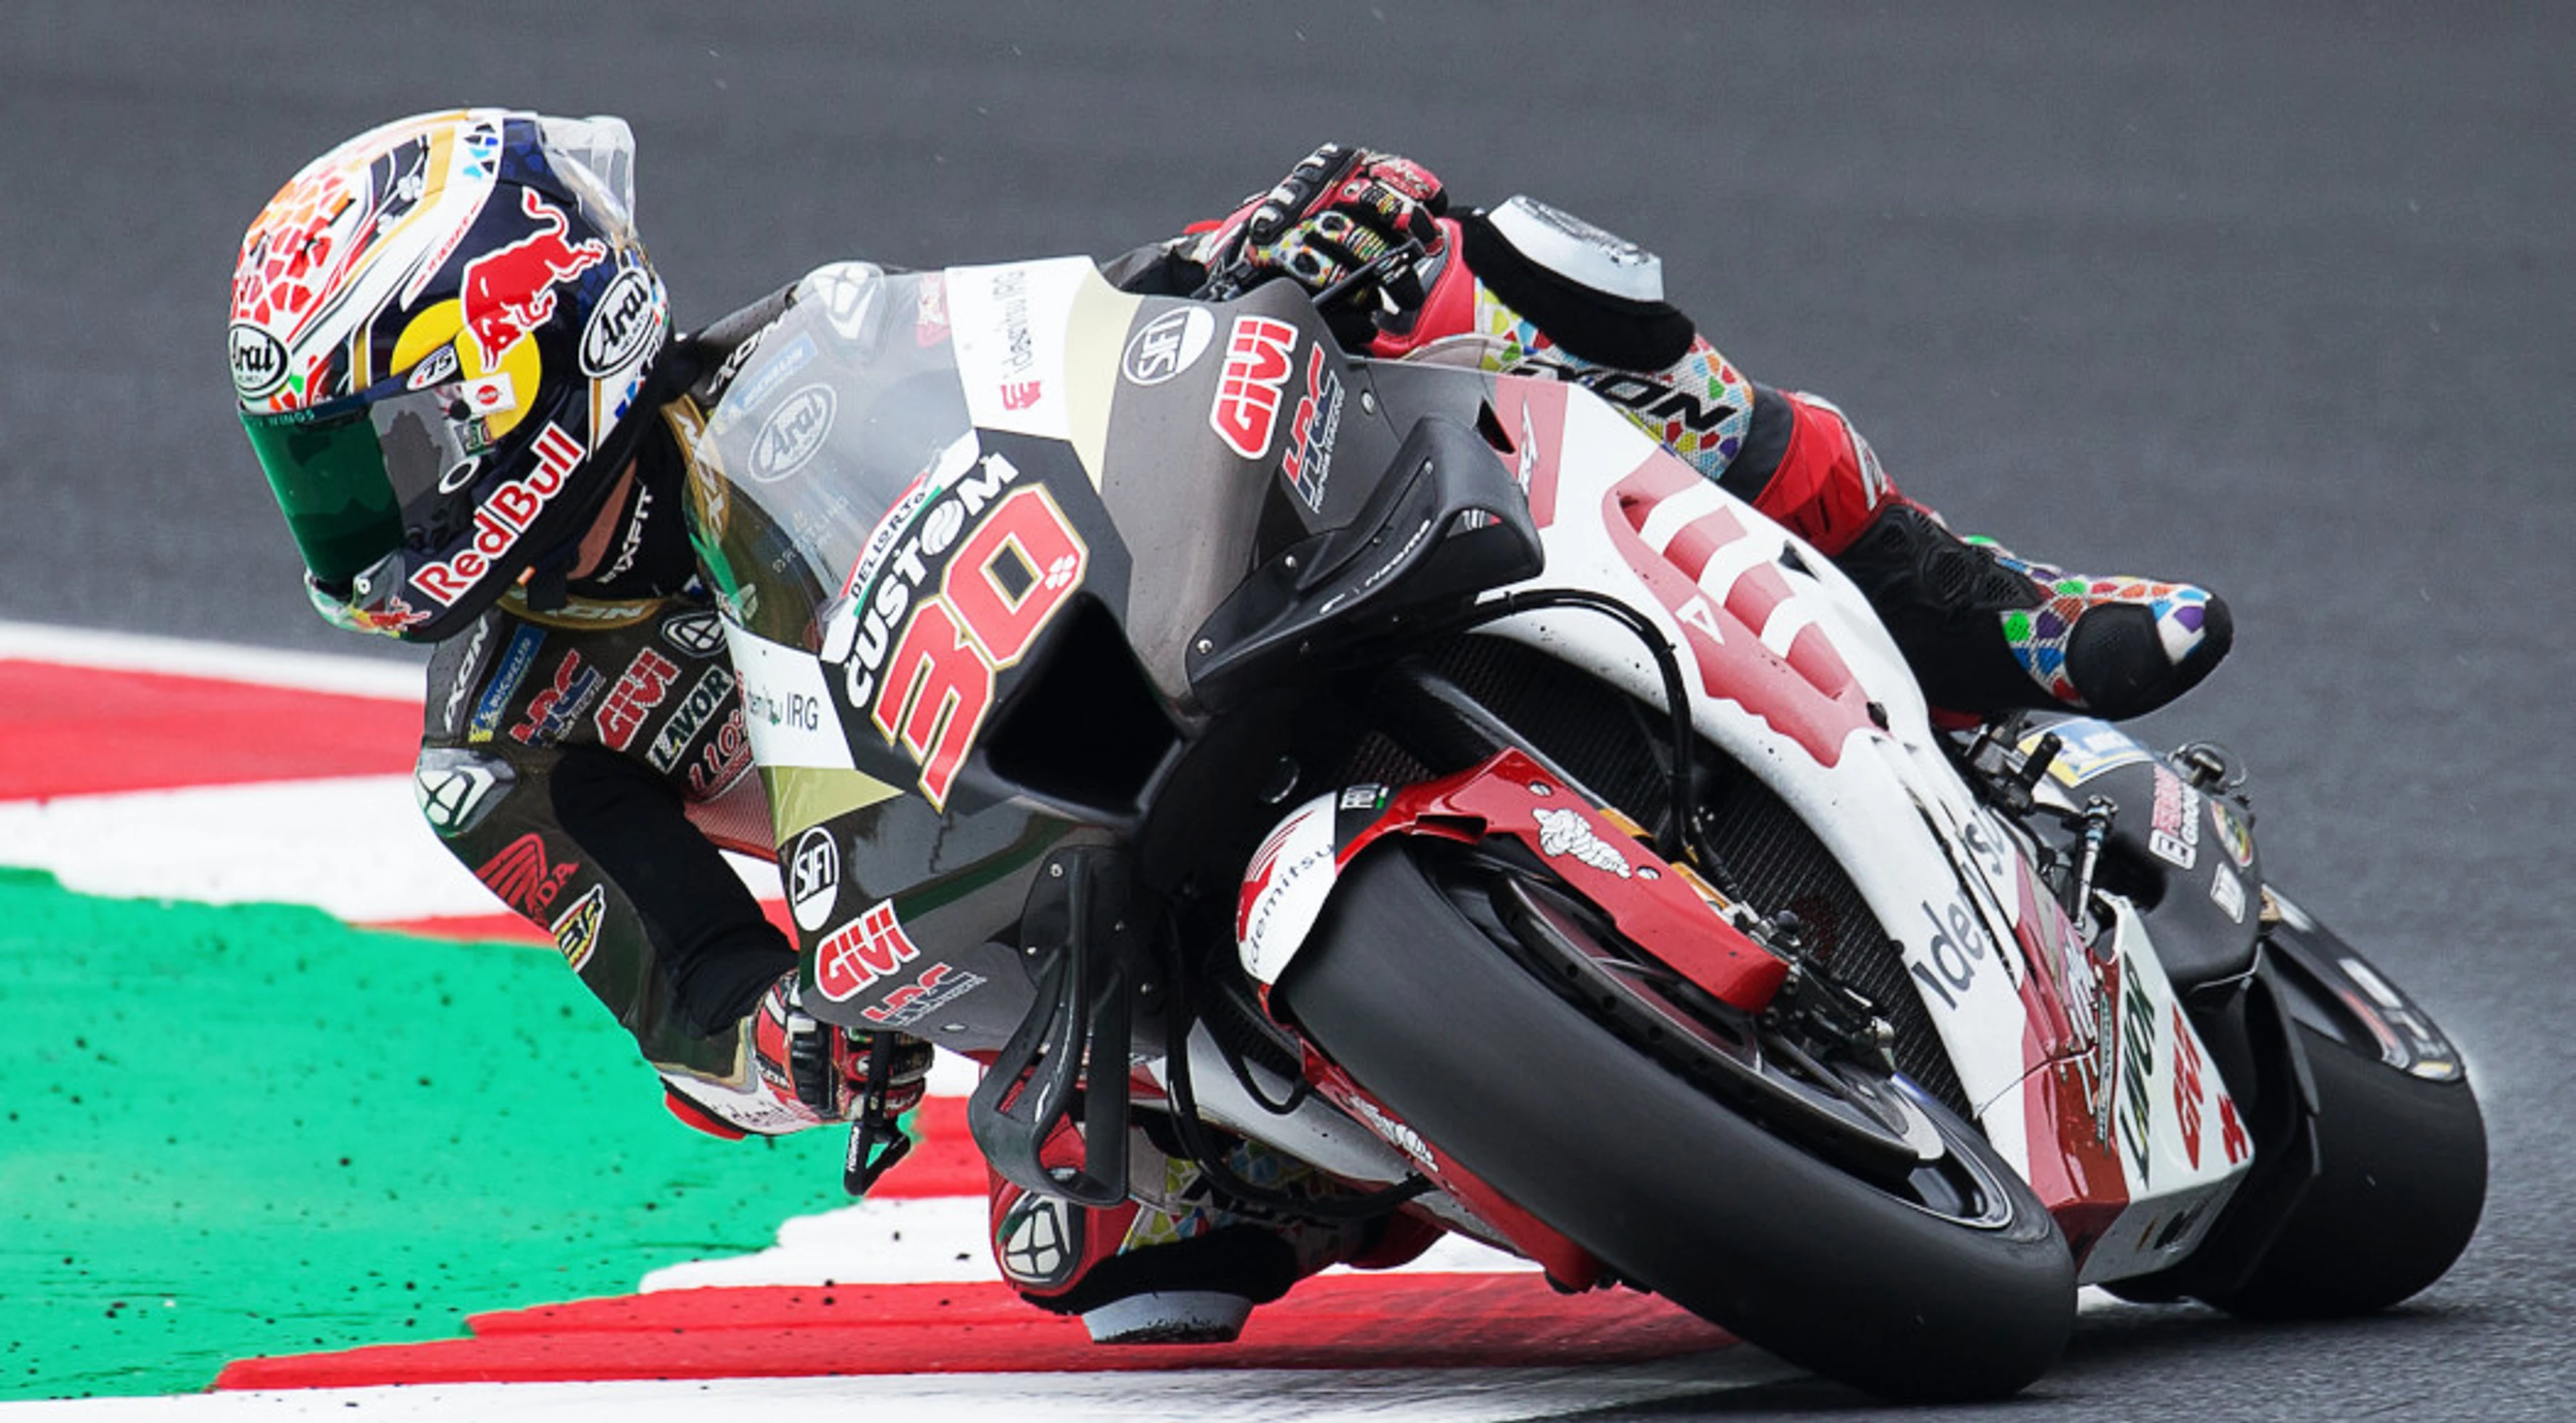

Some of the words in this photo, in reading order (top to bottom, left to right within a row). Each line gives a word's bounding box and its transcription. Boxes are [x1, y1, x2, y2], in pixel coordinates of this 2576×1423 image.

[596, 281, 649, 356] Arai
[1138, 320, 1186, 377] SIFI
[765, 389, 823, 471] Arai
[1210, 315, 1298, 459] GIVI
[1282, 341, 1339, 508] HRC
[411, 506, 519, 606] Red
[483, 422, 587, 535] Bull
[845, 453, 1020, 708] CUSTOM
[510, 648, 599, 743] HRC
[597, 646, 681, 751] GIVI
[871, 482, 1089, 814] 30
[653, 668, 731, 770] LAVOR
[785, 692, 819, 730] IRG
[796, 842, 830, 906] SIFI
[814, 898, 921, 1002] GIVI
[861, 962, 981, 1026] HRC
[2119, 951, 2155, 1192] LAVOR
[2171, 1001, 2204, 1171] GIVI
